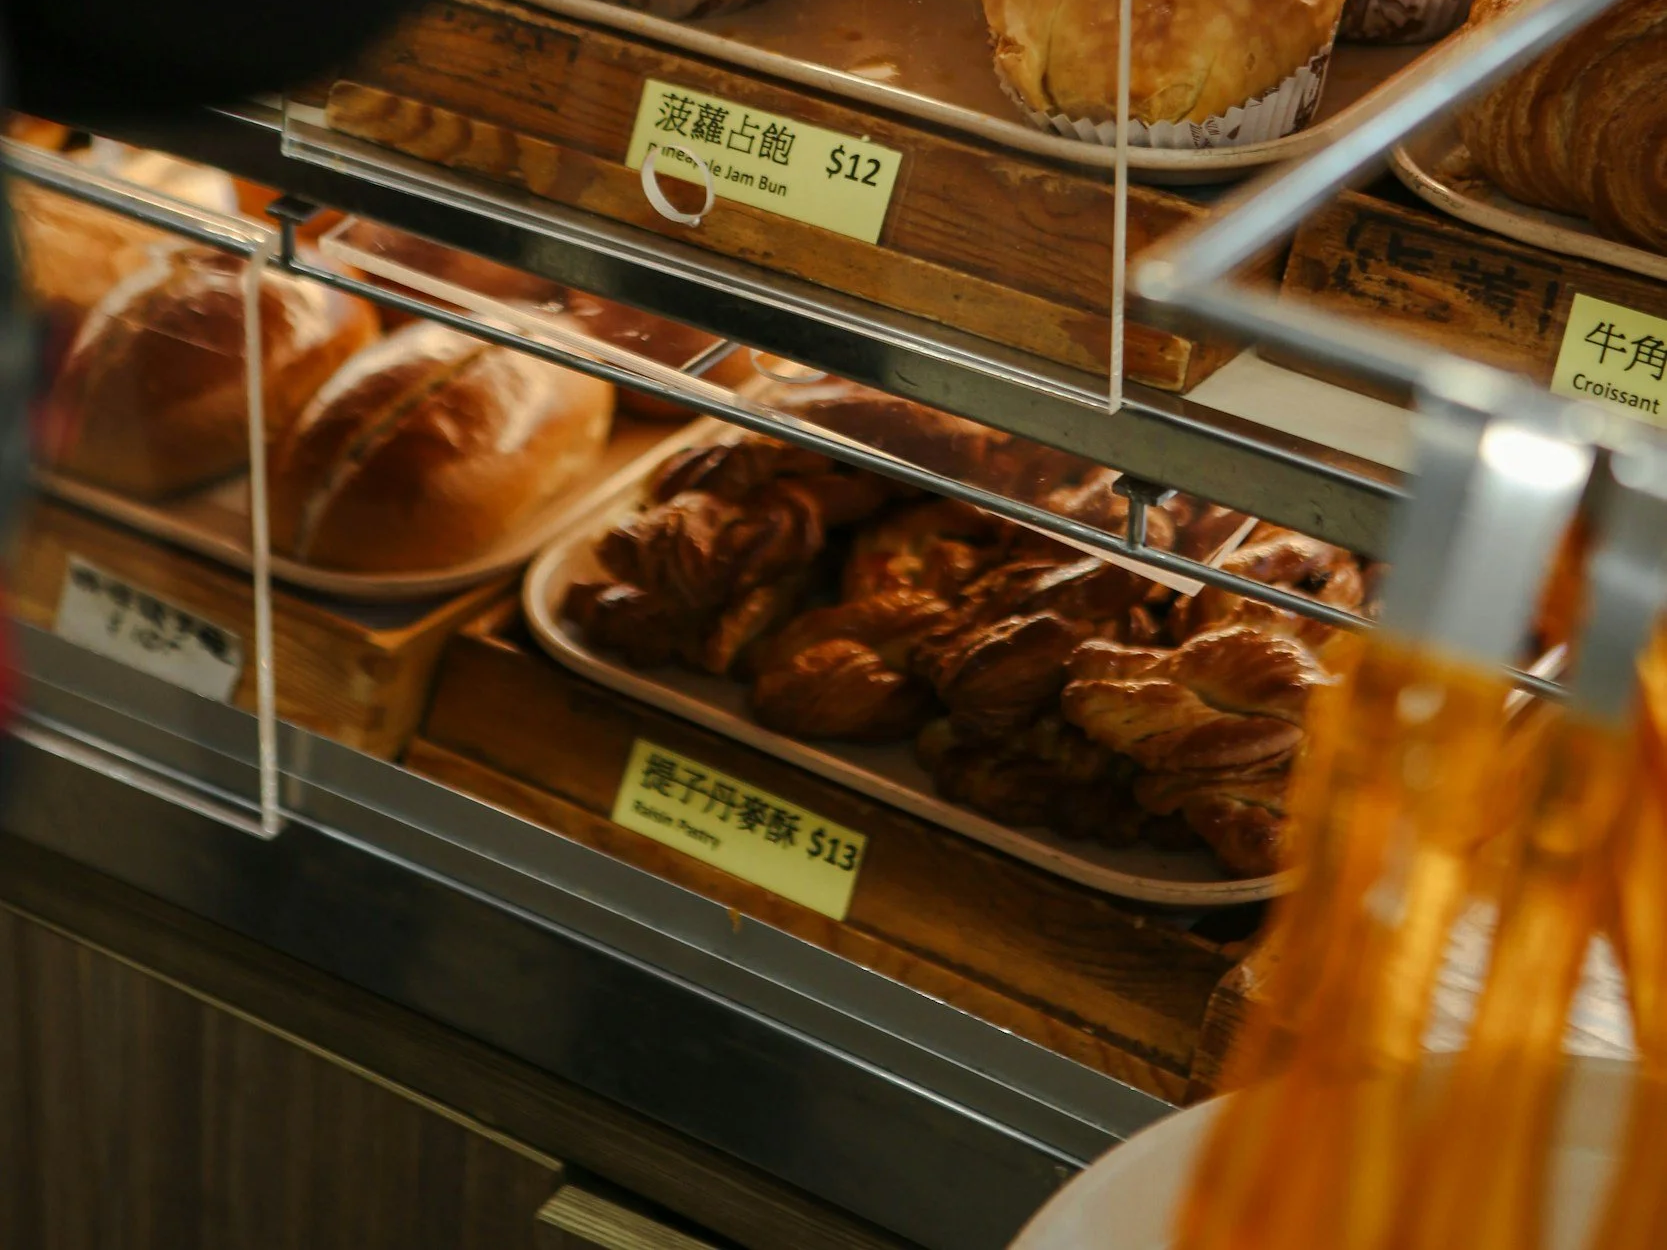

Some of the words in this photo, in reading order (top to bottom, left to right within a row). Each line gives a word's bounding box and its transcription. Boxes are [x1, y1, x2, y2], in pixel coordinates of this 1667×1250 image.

[654, 93, 796, 166] 菠蘿占飽
[825, 145, 881, 187] $12
[724, 165, 754, 188] Jam
[758, 175, 787, 197] Bun
[1585, 322, 1667, 380] 牛角
[1572, 373, 1660, 415] Croissant
[807, 827, 858, 872] $13
